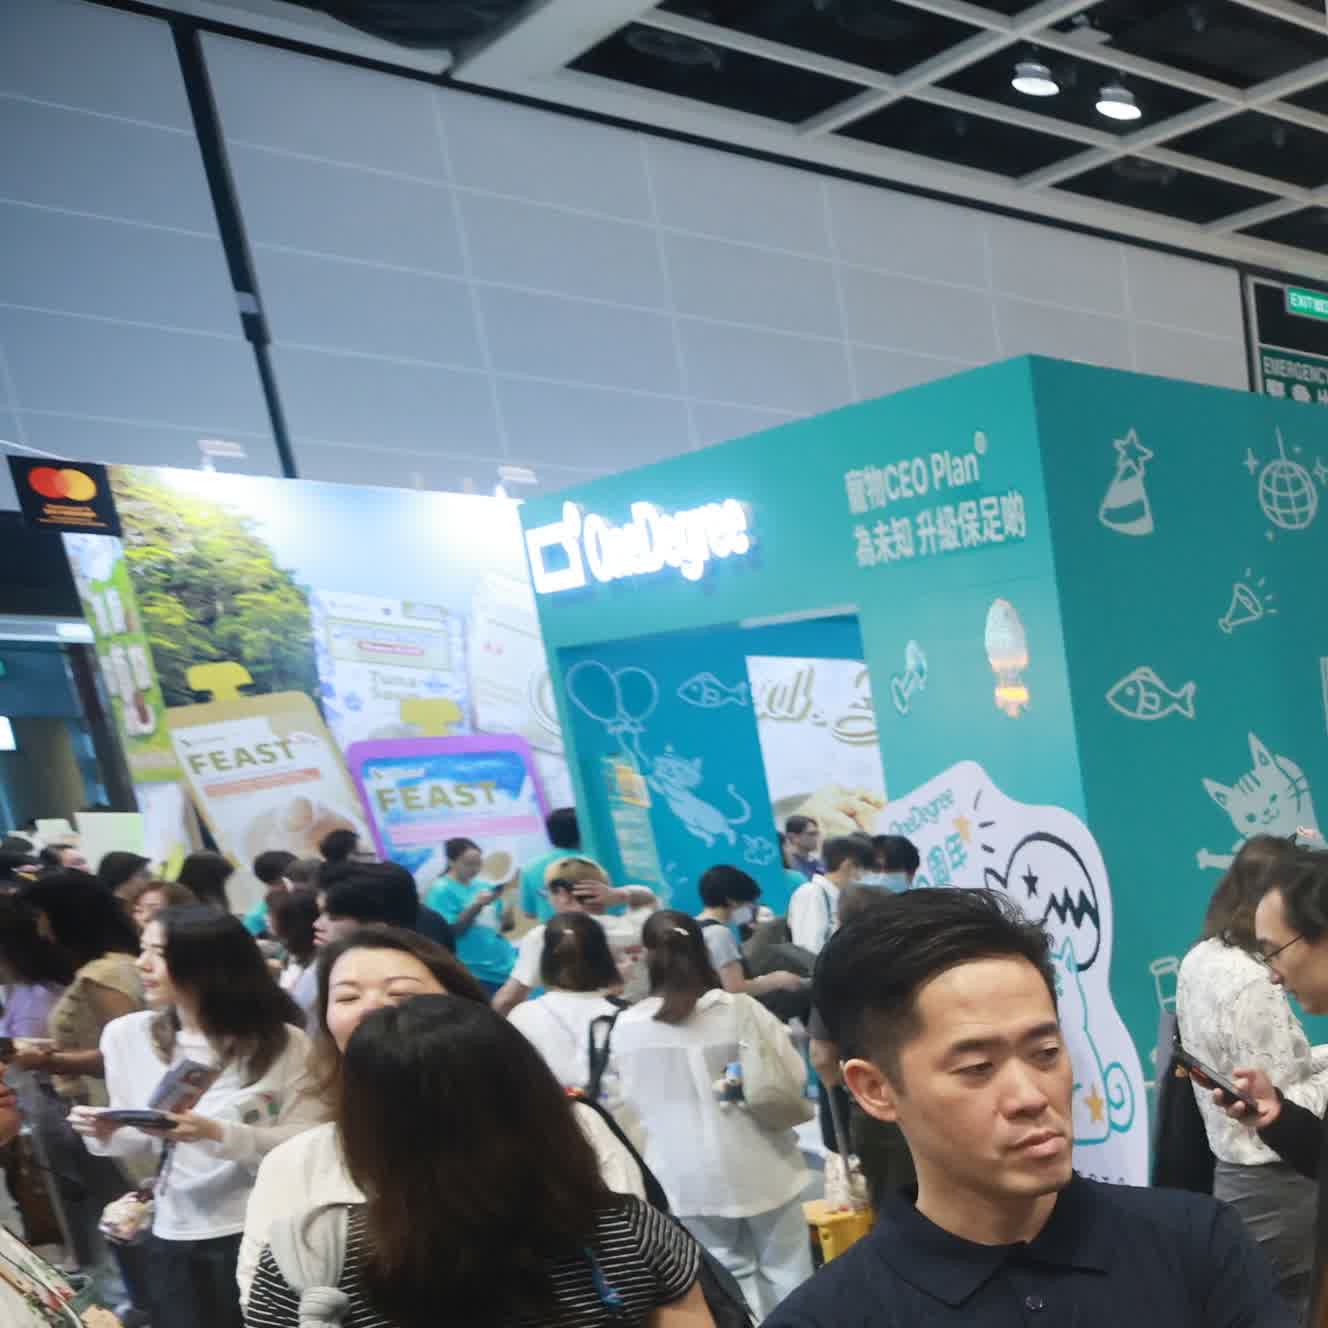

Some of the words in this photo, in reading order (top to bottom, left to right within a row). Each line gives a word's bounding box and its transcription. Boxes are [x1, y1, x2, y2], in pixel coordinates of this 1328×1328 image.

[583, 498, 751, 583] OneDegree
[186, 738, 299, 776] FEAST
[375, 780, 499, 813] FEAST
